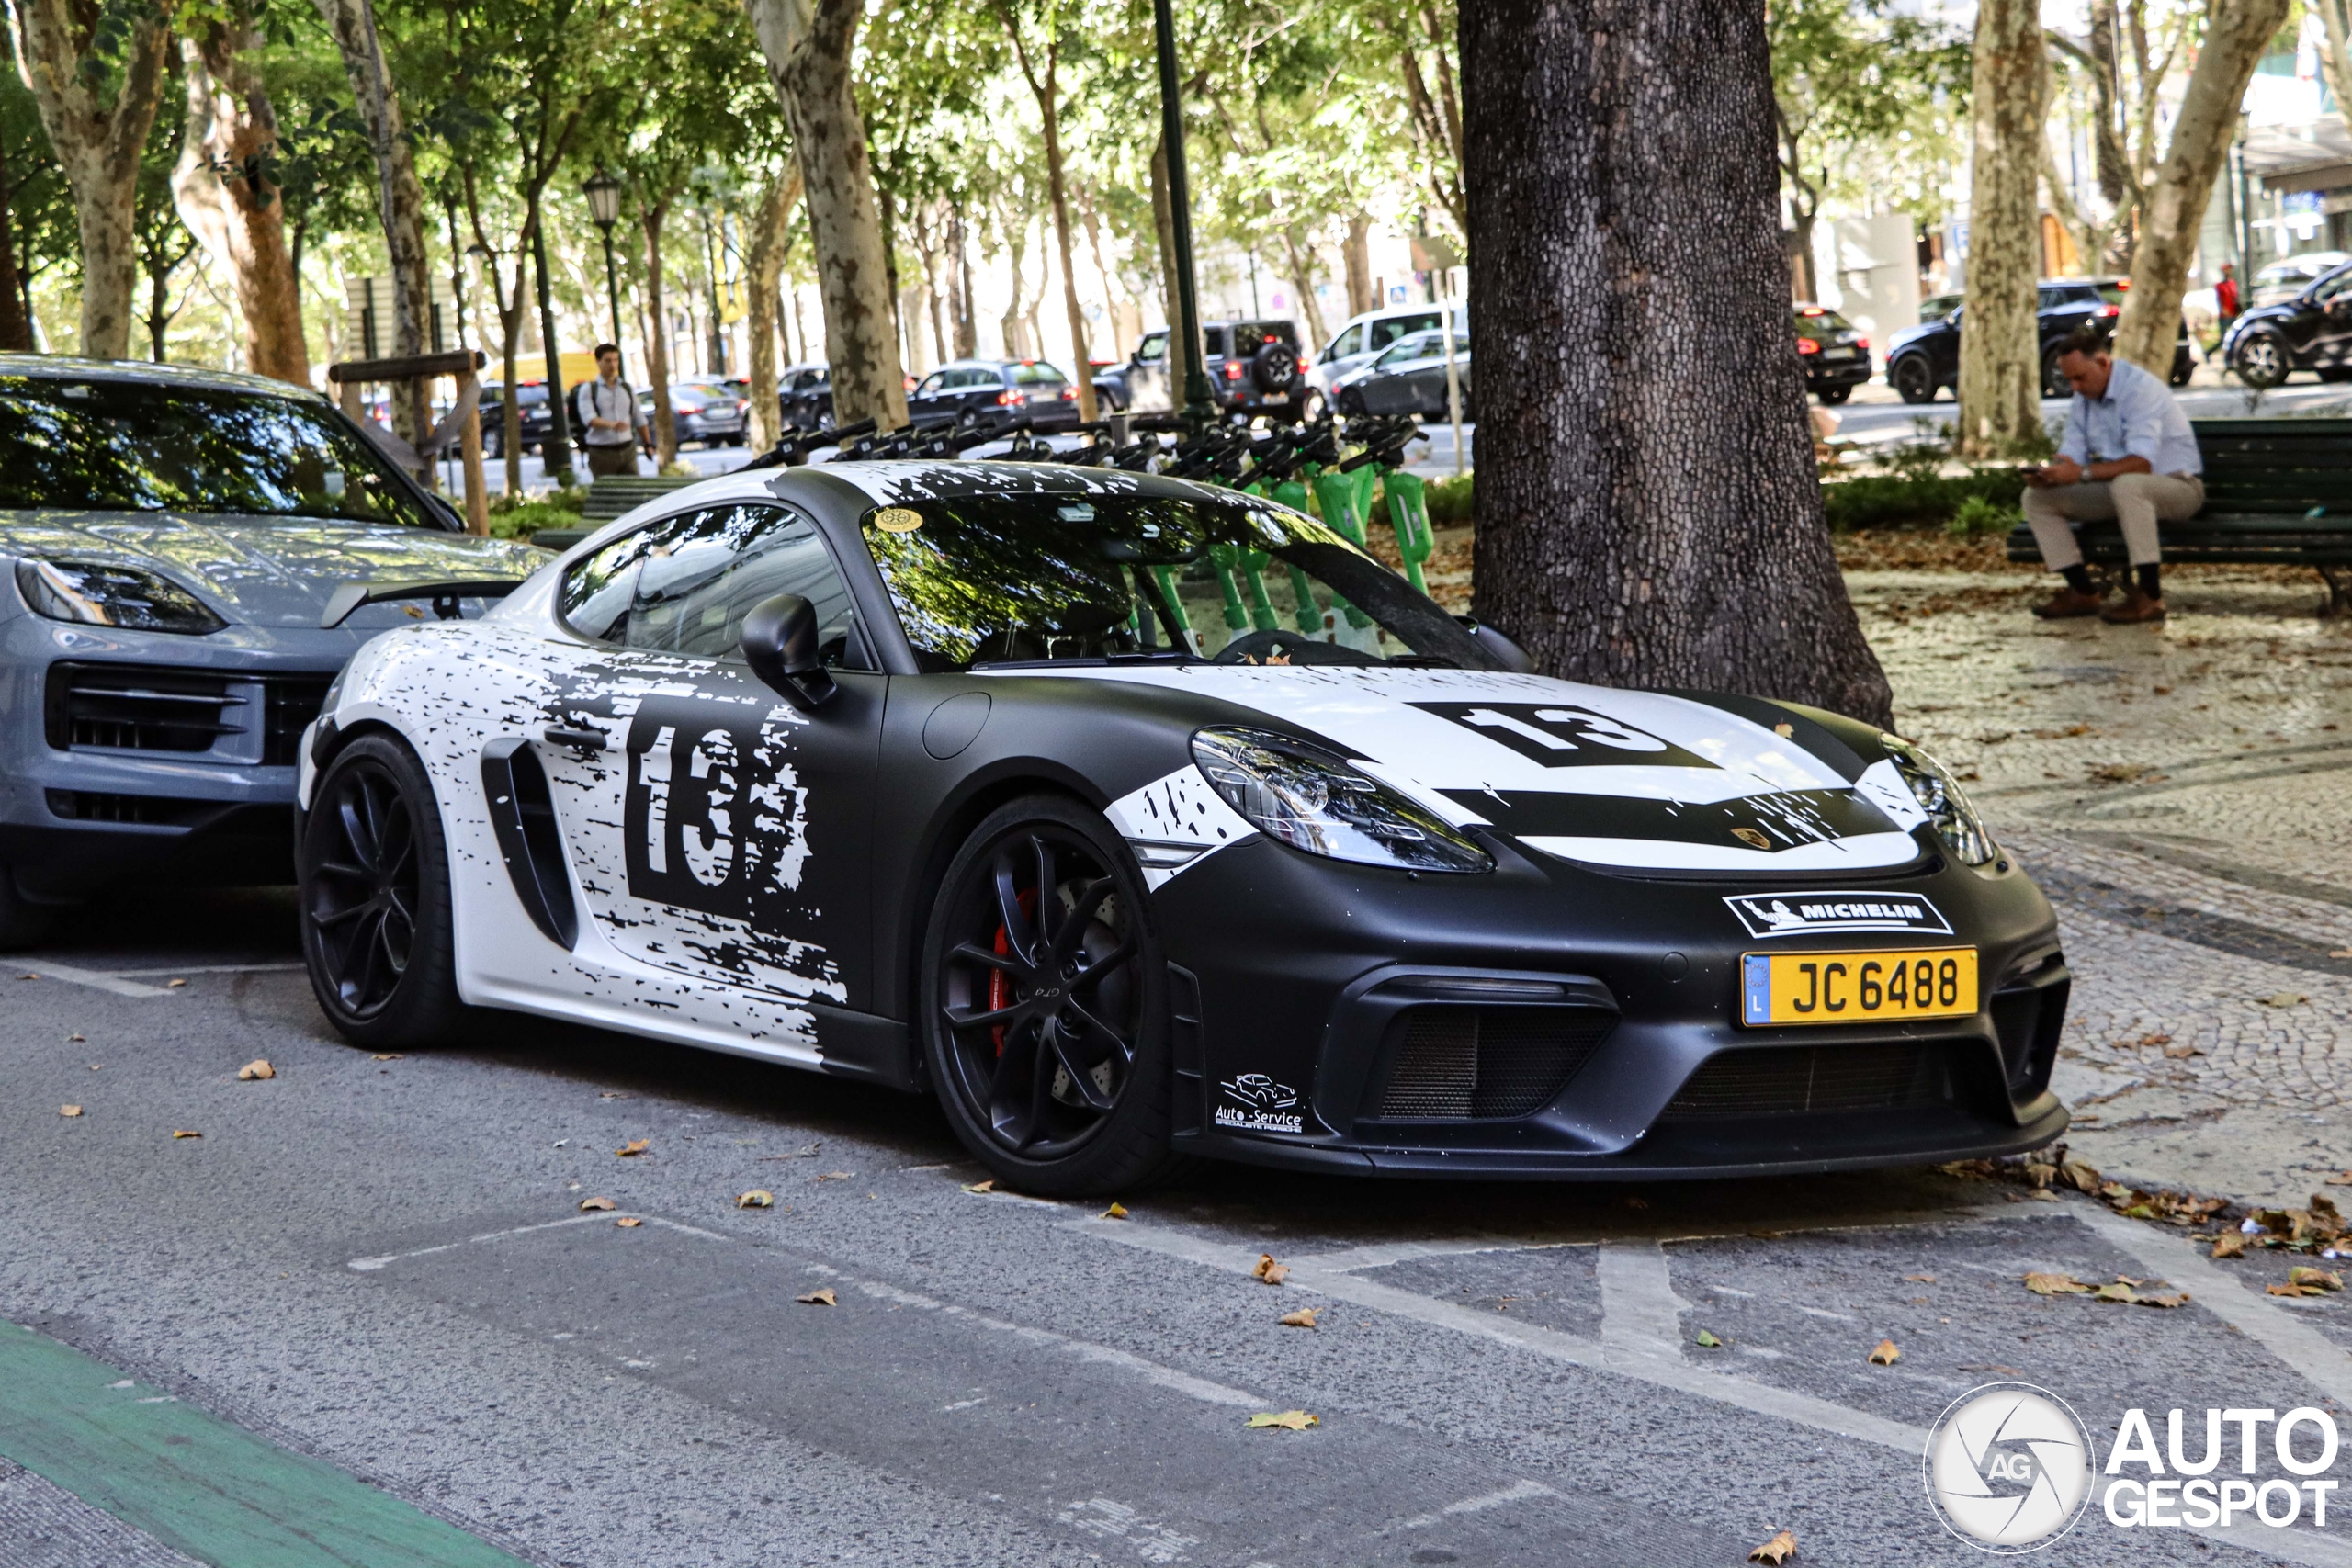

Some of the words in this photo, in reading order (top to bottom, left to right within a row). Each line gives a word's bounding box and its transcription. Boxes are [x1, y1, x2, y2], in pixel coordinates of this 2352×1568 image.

[1460, 708, 1668, 752] 13
[639, 725, 739, 888] 13
[1800, 903, 1924, 919] MICHELIN
[1793, 963, 1847, 1012] JC
[1860, 957, 1958, 1010] 6488
[1752, 994, 1762, 1012] L
[1215, 1105, 1245, 1121] Auto
